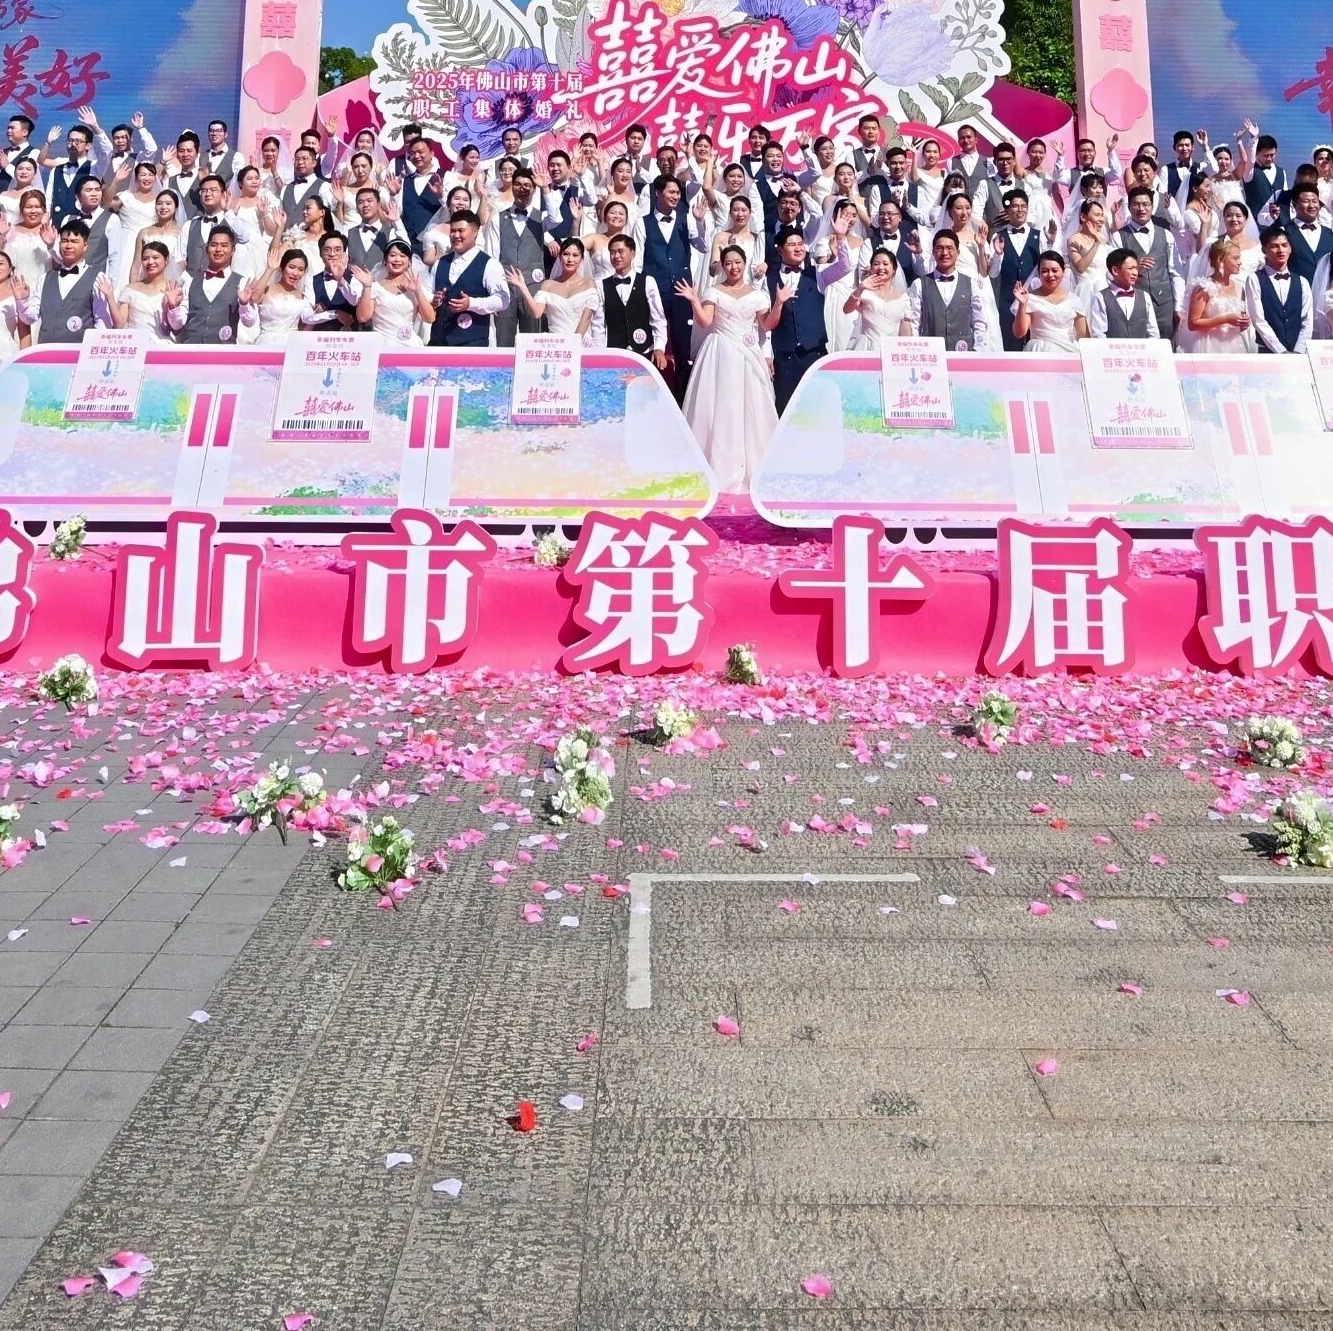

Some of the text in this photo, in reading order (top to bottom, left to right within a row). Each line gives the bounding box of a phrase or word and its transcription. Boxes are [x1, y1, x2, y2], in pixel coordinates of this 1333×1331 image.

[552, 0, 857, 118] 囍爱佛山
[413, 70, 584, 93] 2025年佛山市第十届
[413, 98, 584, 121] 职工集体婚礼
[90, 346, 138, 355] 百年火车站
[526, 350, 572, 359] 百年火车站
[305, 351, 362, 361] 百年火车站
[891, 353, 938, 363] 百年火车站
[1102, 357, 1159, 368] 百年火车站
